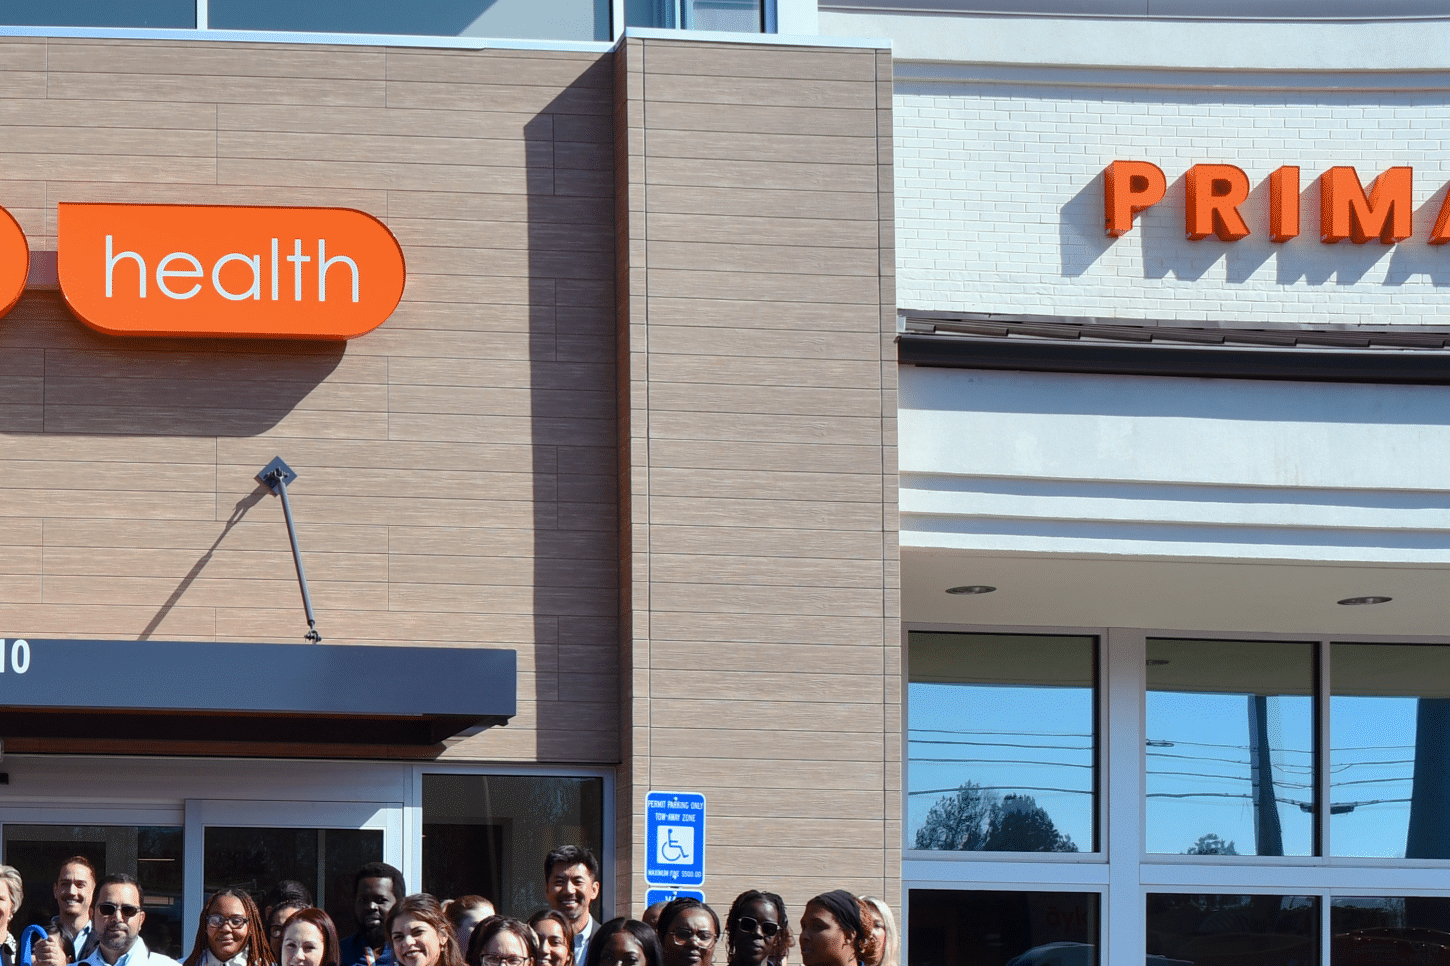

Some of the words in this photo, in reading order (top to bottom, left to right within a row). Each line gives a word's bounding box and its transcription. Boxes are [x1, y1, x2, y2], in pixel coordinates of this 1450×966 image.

[1104, 159, 1450, 244] PRIM
[104, 233, 361, 303] health
[647, 800, 666, 808] PERMIT
[667, 800, 689, 809] PARKING
[690, 801, 705, 810] ONLY
[682, 813, 696, 822] ZONE
[647, 869, 669, 877] MAXIMUM
